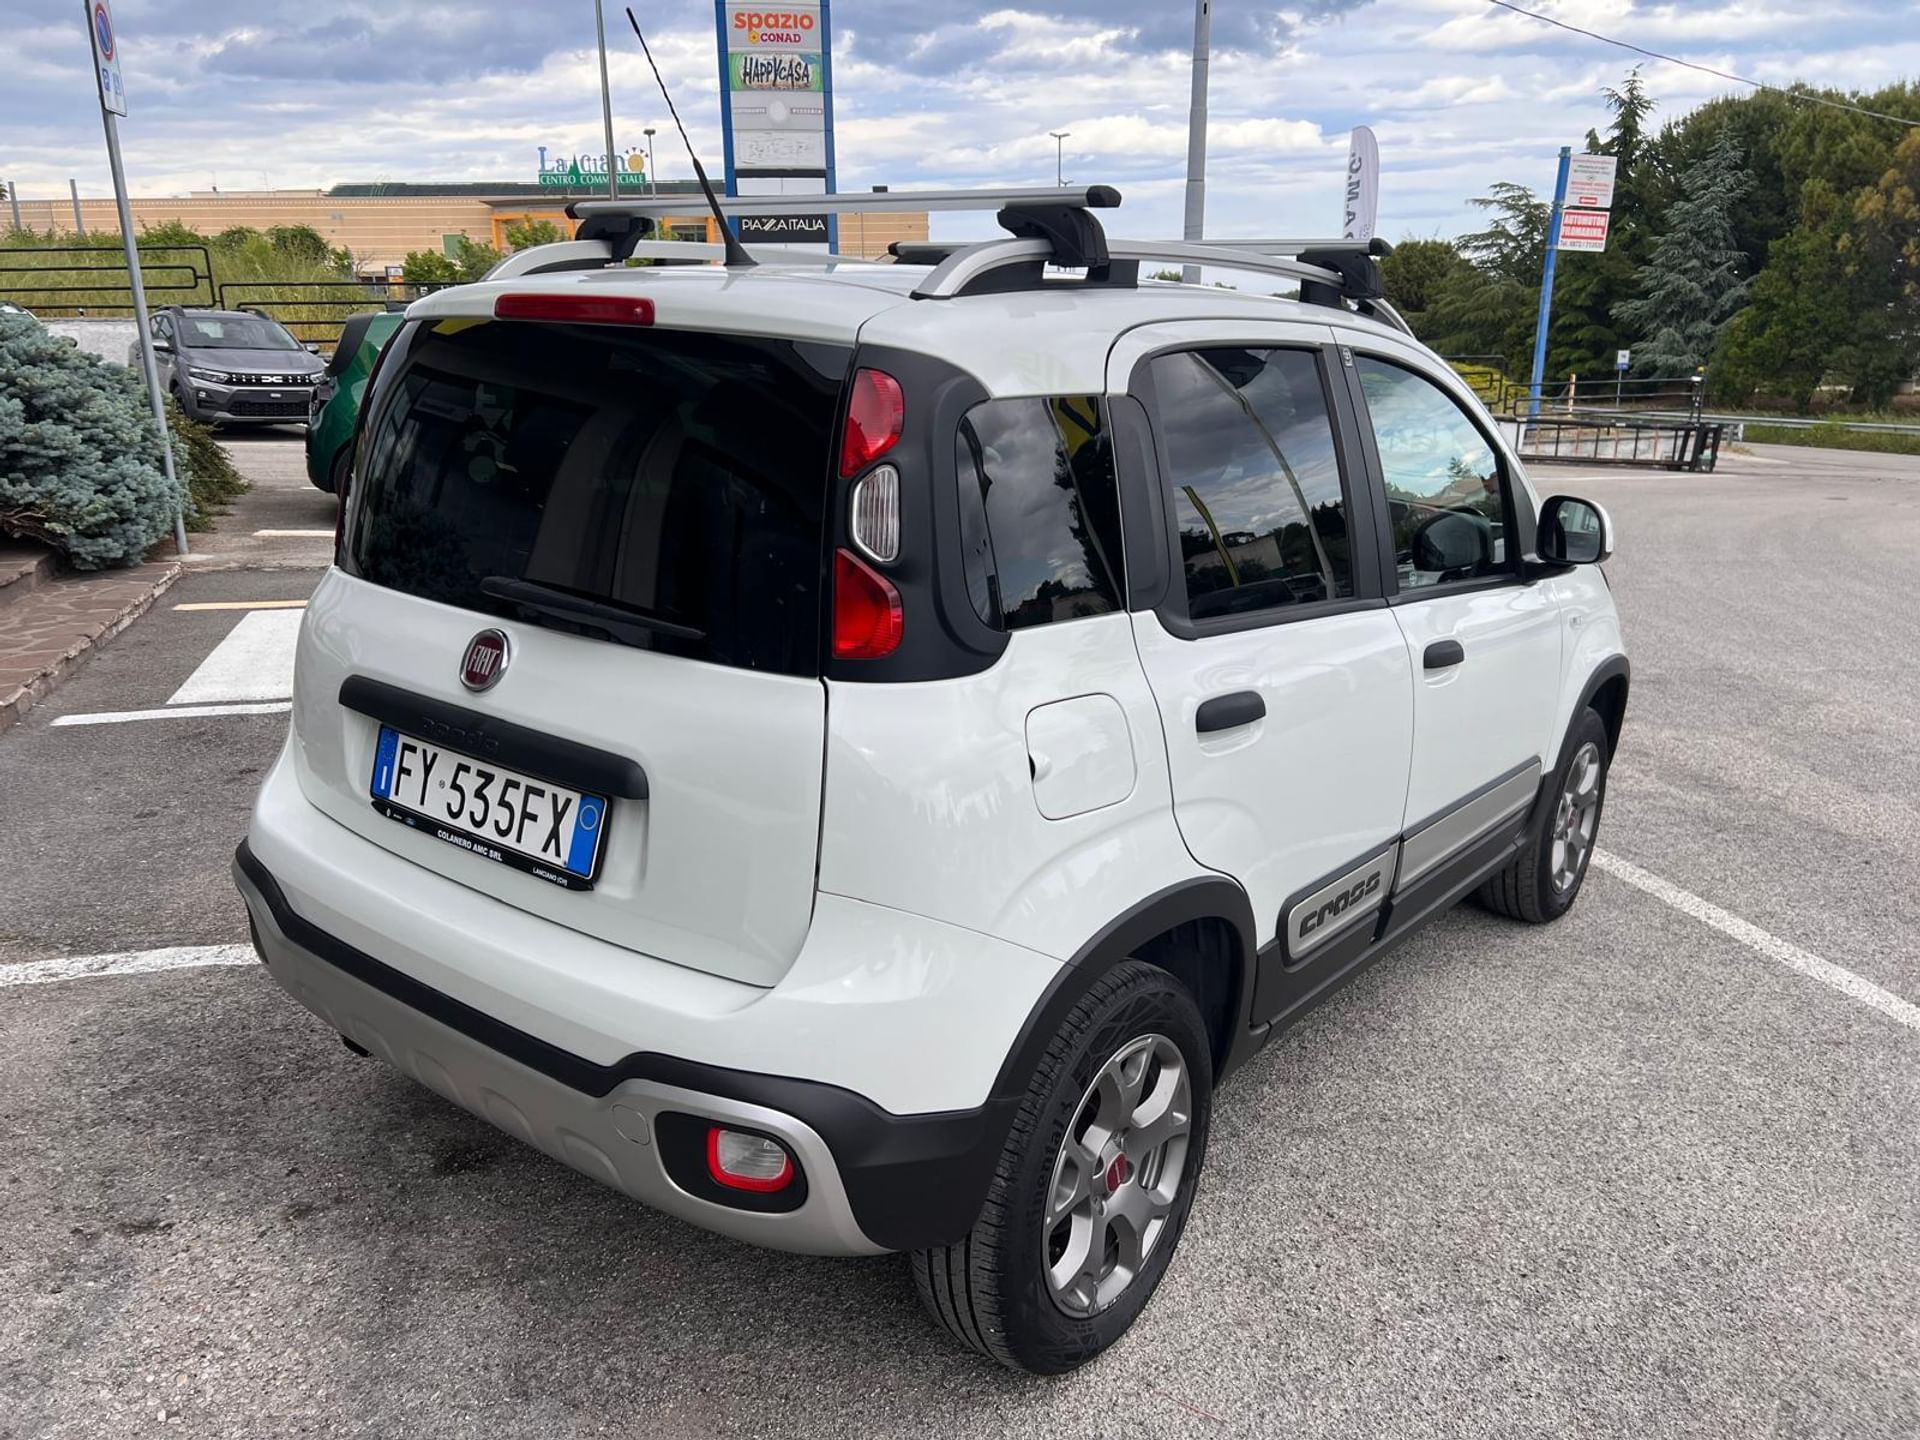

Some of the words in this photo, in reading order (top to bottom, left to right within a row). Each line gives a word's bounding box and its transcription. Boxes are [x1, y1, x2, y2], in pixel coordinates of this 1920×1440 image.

[734, 12, 814, 33] spazio
[760, 33, 802, 43] CONAD
[540, 175, 576, 185] CENTRO
[580, 175, 644, 185] COMMRCIALE
[742, 218, 788, 231] PIAZZA
[789, 218, 825, 231] ITALIA
[467, 645, 501, 676] FIAT
[394, 742, 439, 806] FY
[446, 762, 573, 858] 535FX
[437, 829, 472, 849] COLANERO
[472, 843, 488, 855] AMC
[489, 849, 503, 861] SRL
[532, 867, 557, 881] LANCIANO
